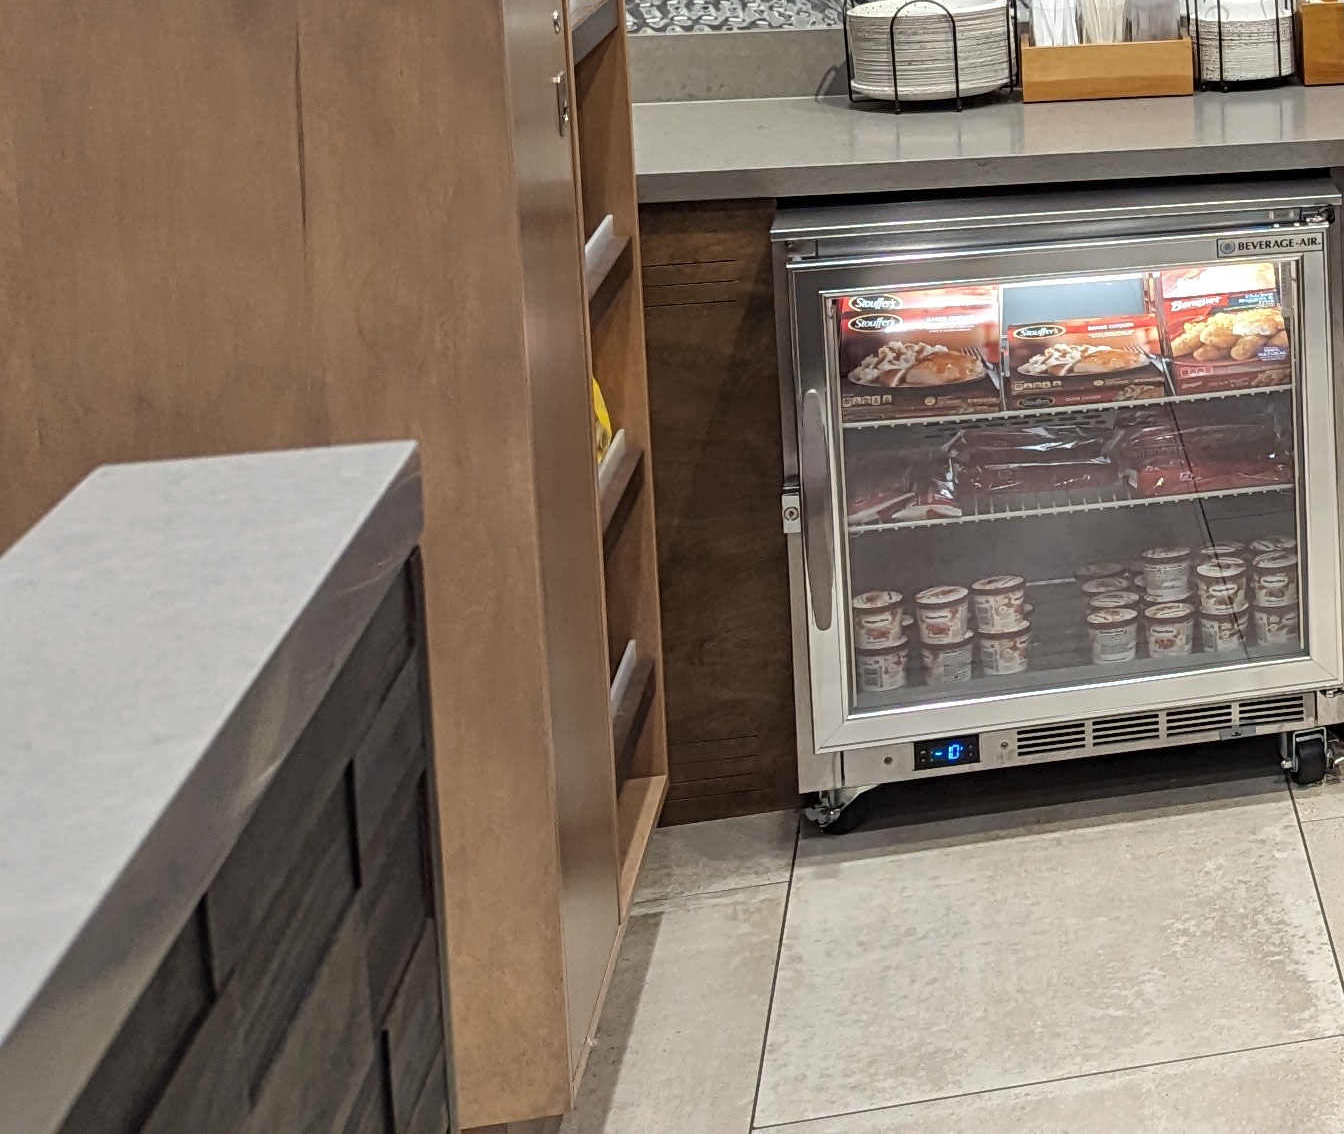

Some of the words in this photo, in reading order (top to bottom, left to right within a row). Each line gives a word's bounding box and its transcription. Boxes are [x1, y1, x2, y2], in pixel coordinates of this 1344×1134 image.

[1238, 237, 1318, 251] BEVERAGE-AIR
[855, 297, 896, 309] Stouffer's
[855, 317, 896, 329] Stouffer's
[1020, 327, 1058, 337] Stouffer's
